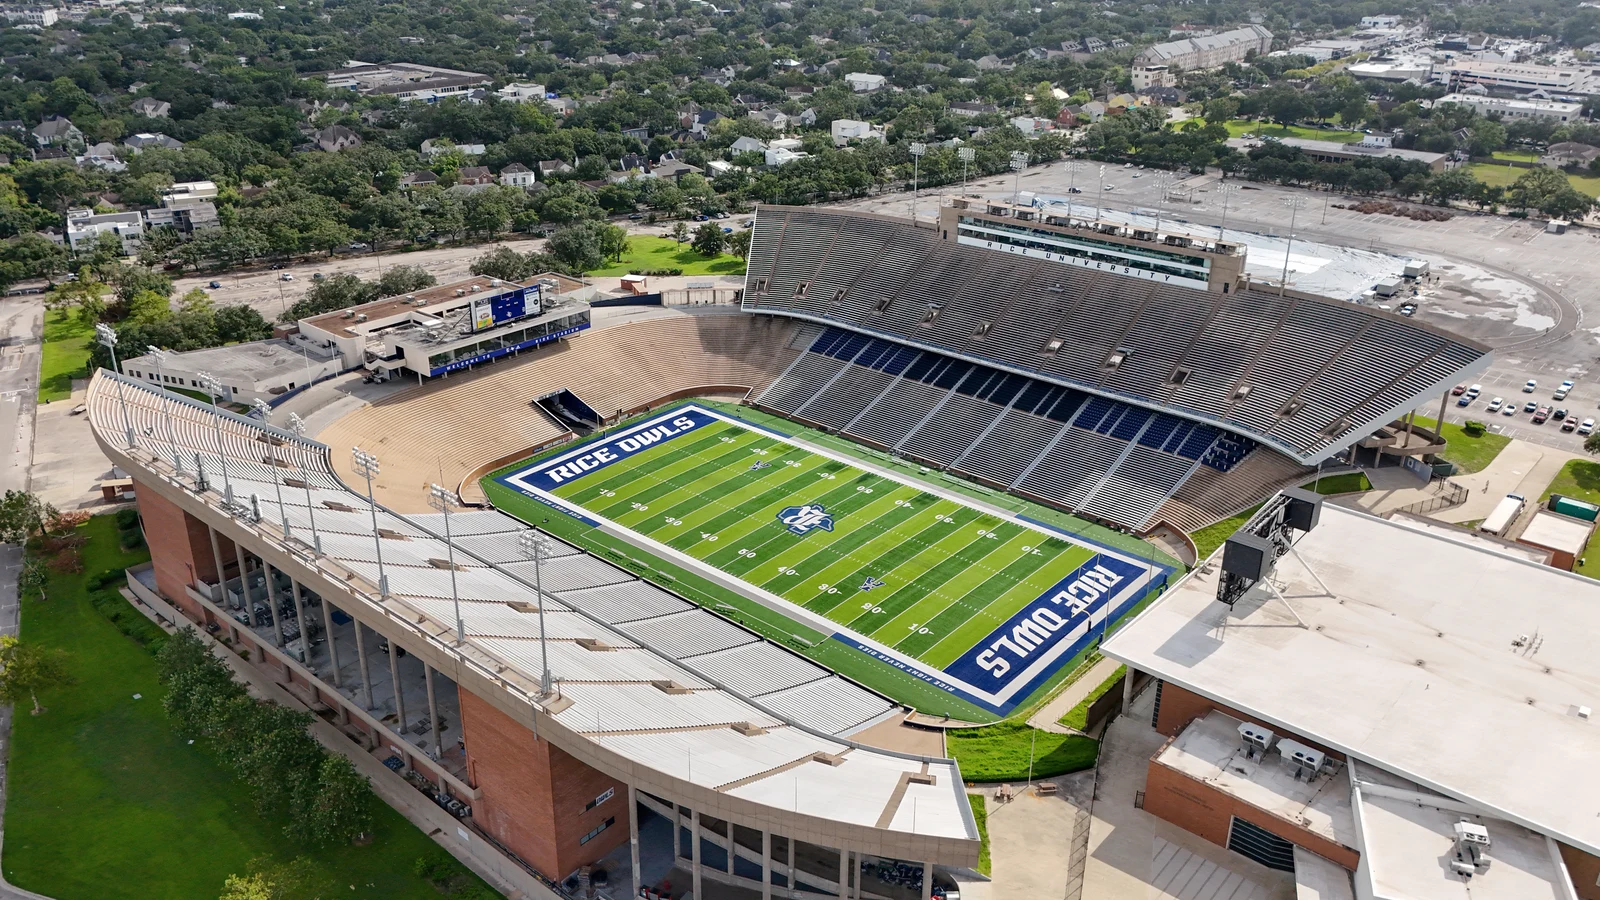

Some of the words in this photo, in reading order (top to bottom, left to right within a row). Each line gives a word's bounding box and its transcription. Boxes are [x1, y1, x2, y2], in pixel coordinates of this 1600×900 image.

[988, 242, 1027, 255] RICE
[1046, 253, 1171, 282] UNIVERSITY
[553, 327, 579, 338] STADIUM
[446, 357, 479, 371] WELCOME
[544, 447, 619, 483] RICE
[615, 416, 696, 452] OWLS
[601, 489, 616, 497] 10
[633, 502, 648, 511] 20
[665, 518, 682, 526] 30
[701, 532, 719, 542] 40
[738, 548, 756, 558] 50
[1021, 545, 1041, 555] 10
[777, 565, 796, 576] 40
[818, 583, 838, 595] 30
[1050, 564, 1124, 618] RICE
[861, 602, 882, 614] 20
[908, 622, 929, 635] 10
[976, 607, 1069, 678] OWLS
[857, 645, 878, 656] DIES
[878, 654, 906, 669] NEVER
[906, 668, 933, 682] FIGHT
[933, 680, 955, 692] RICE
